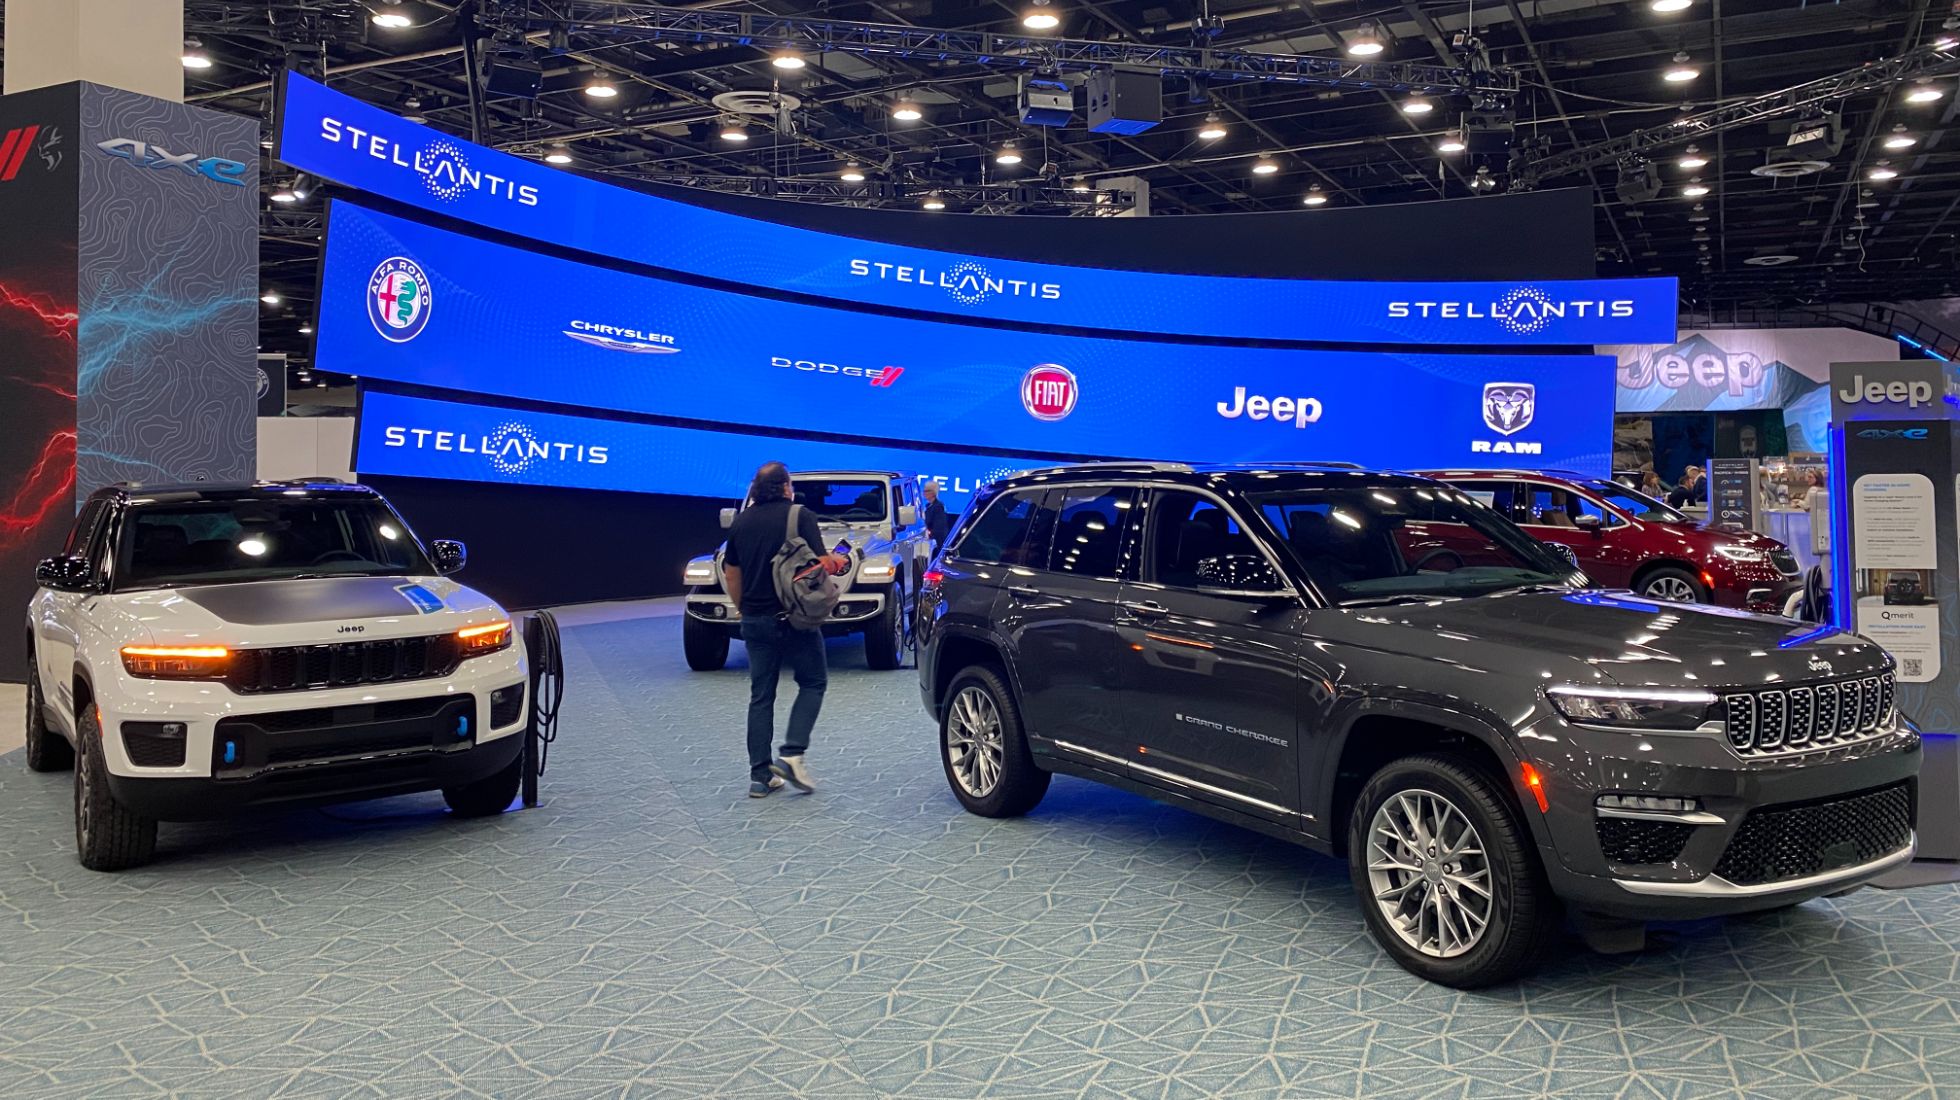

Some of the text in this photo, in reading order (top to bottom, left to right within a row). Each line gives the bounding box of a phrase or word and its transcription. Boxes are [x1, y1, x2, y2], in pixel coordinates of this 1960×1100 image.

[321, 116, 539, 206] STELLANTIS
[371, 261, 429, 306] ALFA ROMEO
[850, 259, 1061, 299] STELLANTIS
[1388, 300, 1634, 318] STELLANTIS
[570, 320, 675, 344] CHRYSLER
[771, 356, 885, 380] DODGE
[1617, 343, 1763, 397] Jeep
[1034, 380, 1067, 407] FIAT
[1839, 375, 1933, 408] Jeep
[1217, 386, 1322, 429] Jeep
[385, 426, 609, 464] STELLANTIS
[1471, 441, 1542, 455] RAM
[337, 625, 365, 634] Jeep
[1881, 611, 1915, 621] Qmerit
[1808, 660, 1833, 671] Jeep
[1185, 715, 1288, 747] GRAND CHEROKEE
